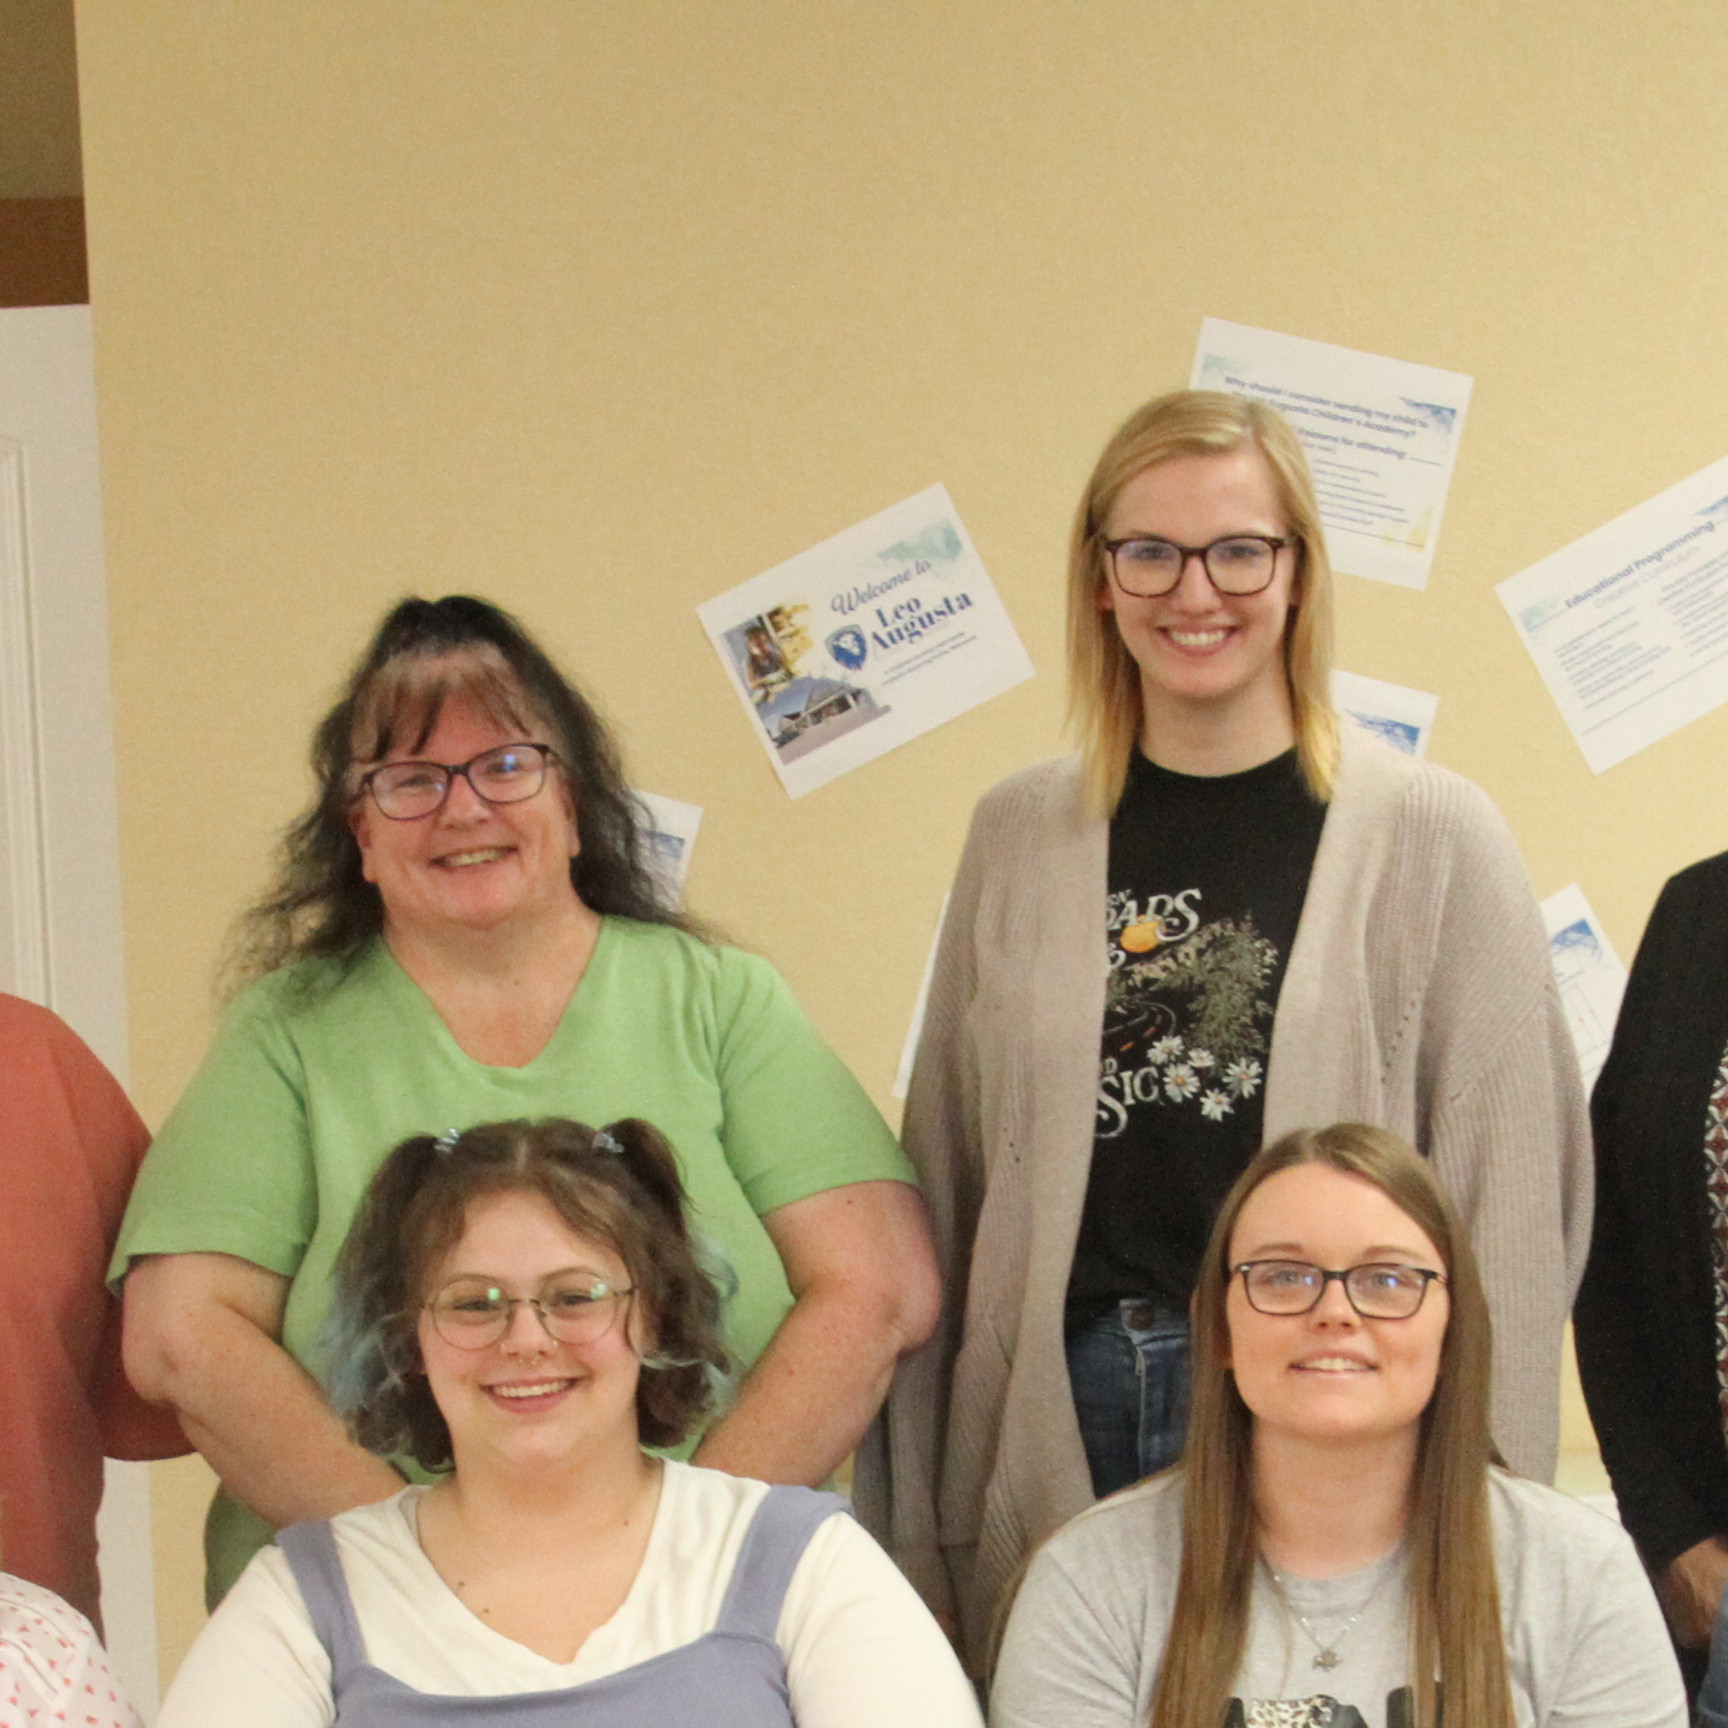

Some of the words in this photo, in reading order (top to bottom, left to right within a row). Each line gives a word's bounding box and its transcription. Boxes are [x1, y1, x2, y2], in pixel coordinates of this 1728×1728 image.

[831, 569, 912, 616] Welcome
[915, 560, 931, 575] to
[1565, 564, 1633, 609] Educational
[1634, 520, 1715, 570] Programming
[872, 593, 974, 649] Augusta
[876, 598, 922, 628] Leo
